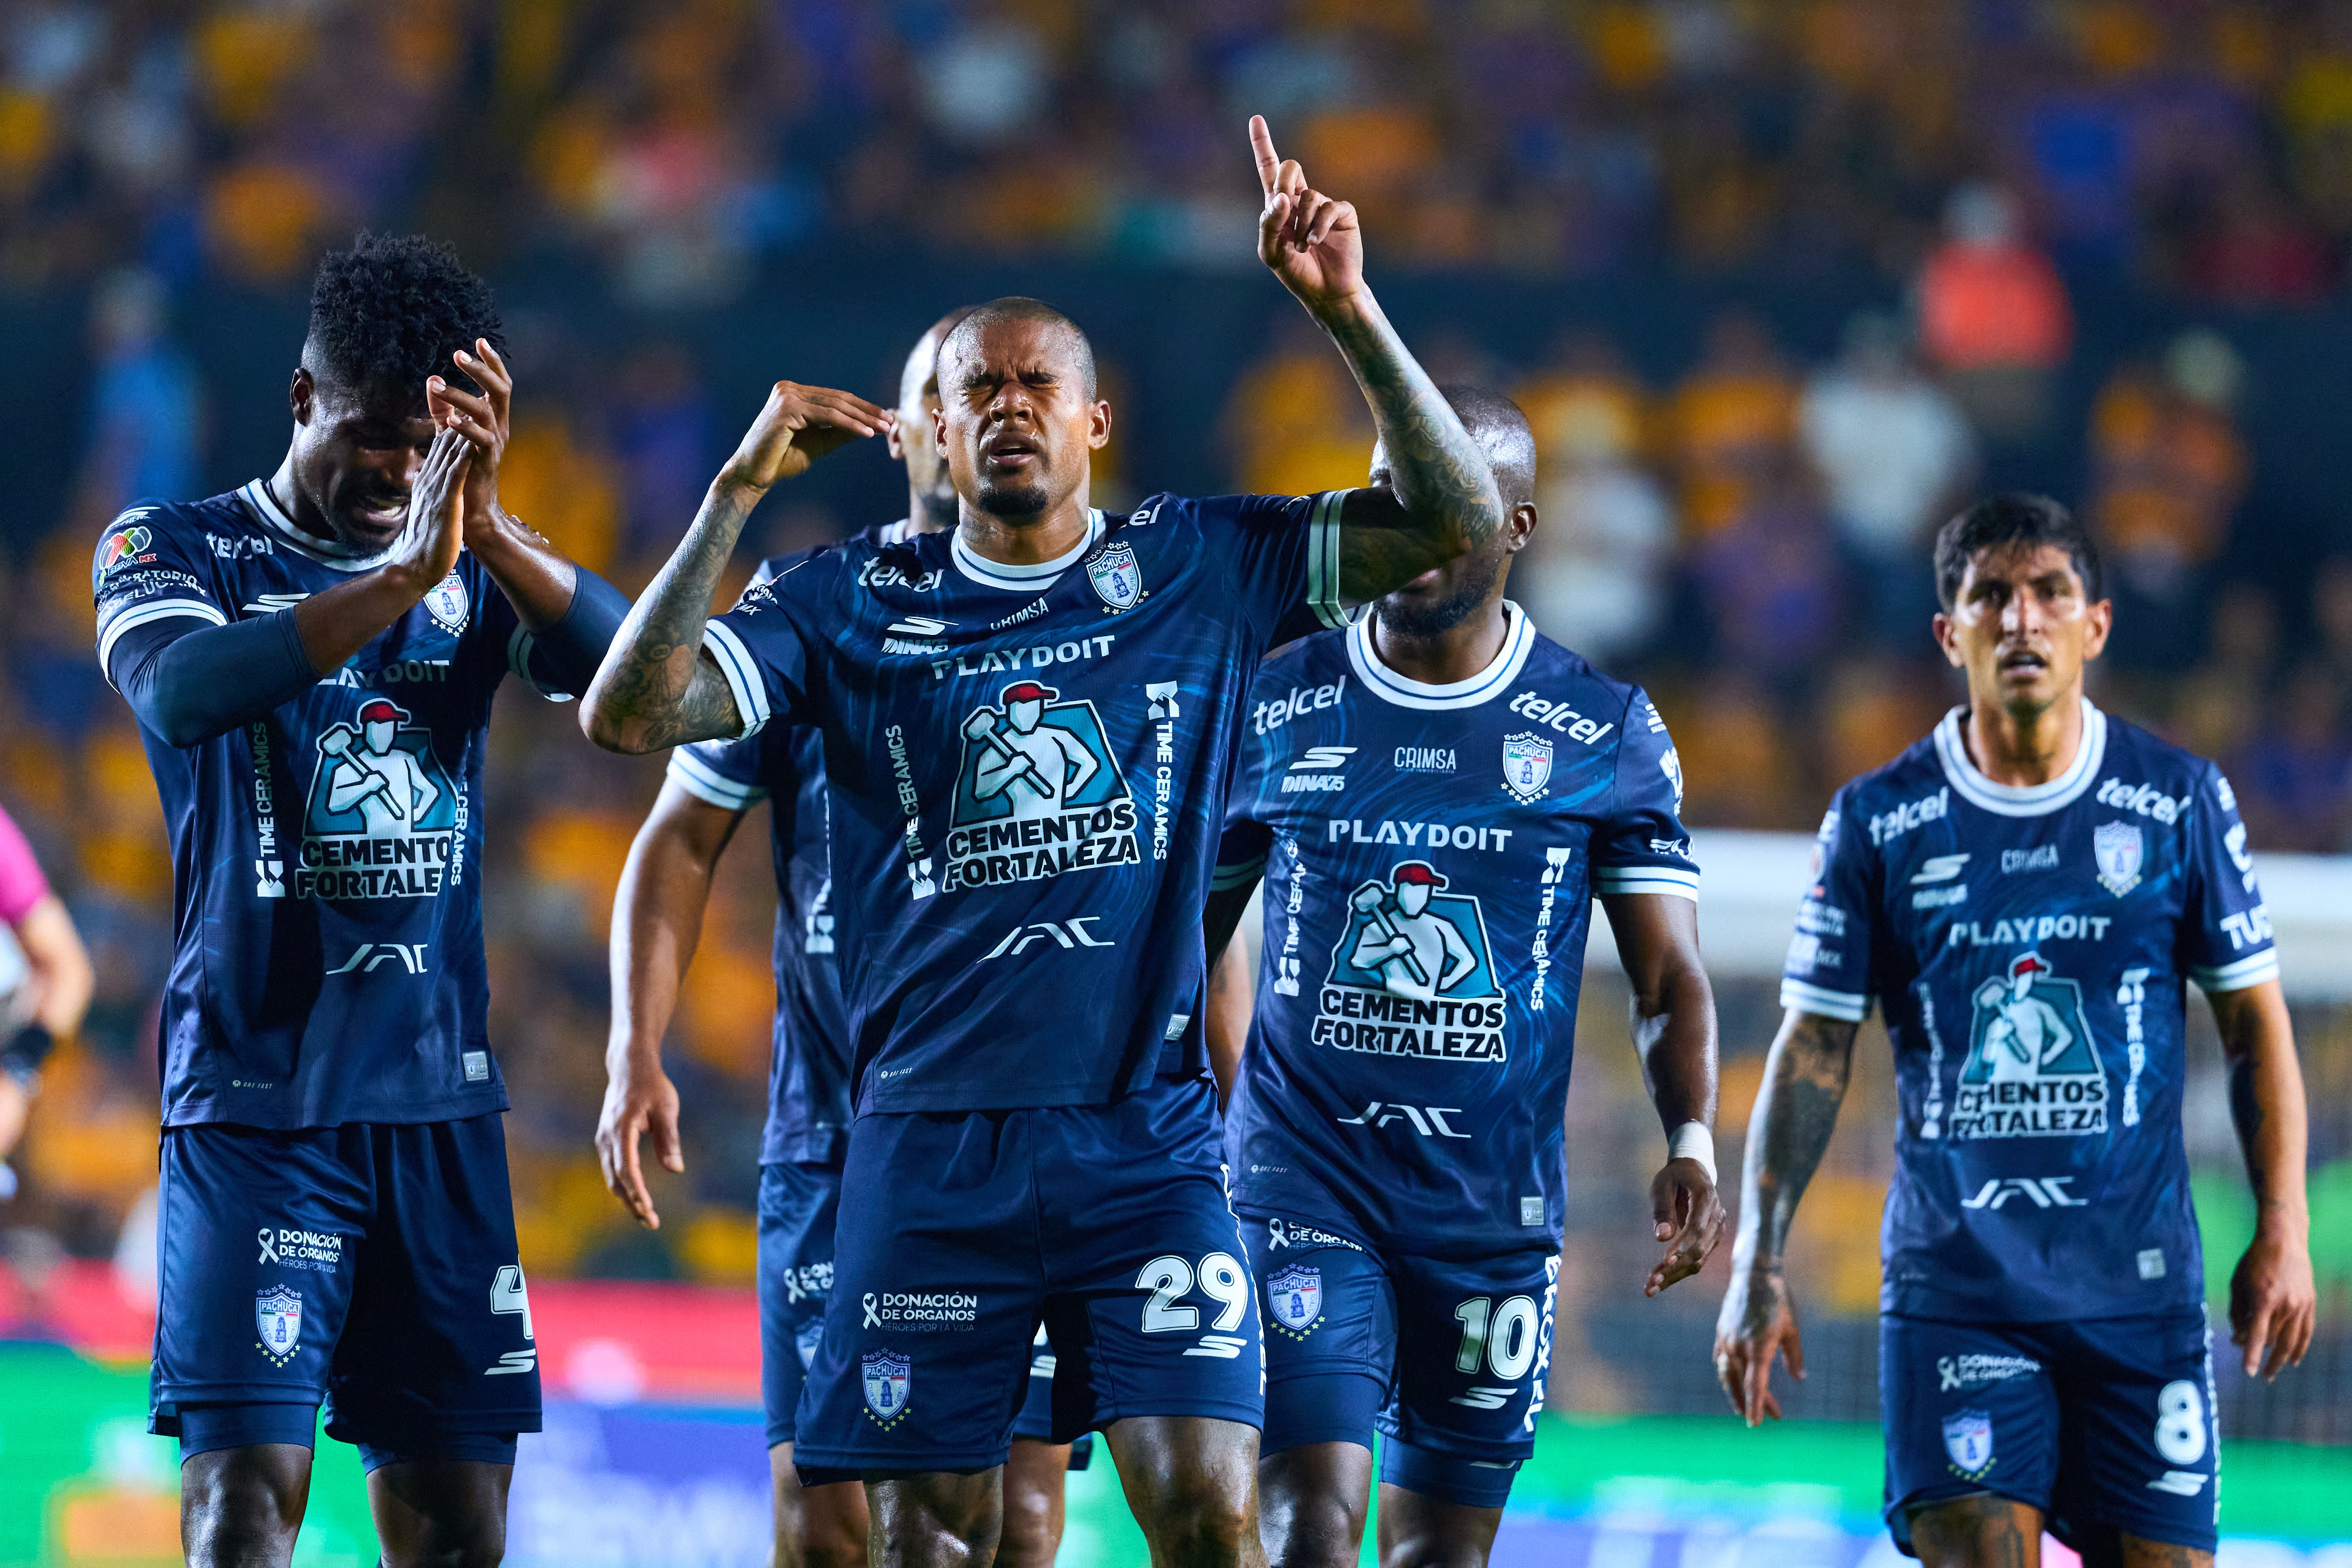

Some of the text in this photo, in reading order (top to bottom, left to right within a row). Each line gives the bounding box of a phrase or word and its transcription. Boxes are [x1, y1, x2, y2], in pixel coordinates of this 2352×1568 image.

[1093, 555, 1130, 575] PACHUCA
[931, 635, 1115, 680] PLAYDOIT
[1253, 674, 1347, 735] telcel
[1509, 691, 1614, 745] telcel
[1394, 747, 1456, 770] CRIMSA
[1509, 746, 1546, 759] PACHUCA
[253, 721, 275, 857] TIME CERAMICS
[884, 724, 924, 860] TIME CERAMICS
[1153, 720, 1174, 861] TIME CERAMICS
[2096, 776, 2192, 826] telcel
[948, 804, 1135, 858] CEMENTOS
[1869, 785, 1949, 846] telcel
[302, 836, 450, 868] CEMENTO
[451, 795, 468, 887] CERAMICS
[1329, 819, 1513, 852] PLAYDOIT
[945, 834, 1138, 890] FORTALEZA
[297, 867, 442, 897] FORTALE
[1531, 885, 1556, 1011] TIME CERAMICS
[1949, 914, 2112, 947] PLAYDOIT
[1323, 989, 1504, 1028] CEMENTOS
[1314, 1018, 1504, 1059] FORTALEZA
[279, 1229, 342, 1250] DONACIÓN
[279, 1243, 340, 1263] DE ÓRGANOS
[1289, 1230, 1309, 1241] DE
[279, 1258, 308, 1270] HÉROES
[490, 1254, 533, 1340] 4
[883, 1291, 977, 1309] DONACIÓN
[1135, 1252, 1248, 1333] 29
[1272, 1278, 1315, 1292] PACHUCA
[261, 1300, 298, 1313] PACHUCA
[881, 1306, 976, 1321] DE ÓRGANOS
[882, 1321, 916, 1332] HÉROES
[918, 1323, 937, 1332] POR
[954, 1323, 975, 1332] VIDA
[1455, 1295, 1538, 1380] 10
[867, 1365, 905, 1376] PACHUCA
[2154, 1380, 2206, 1465] 8
